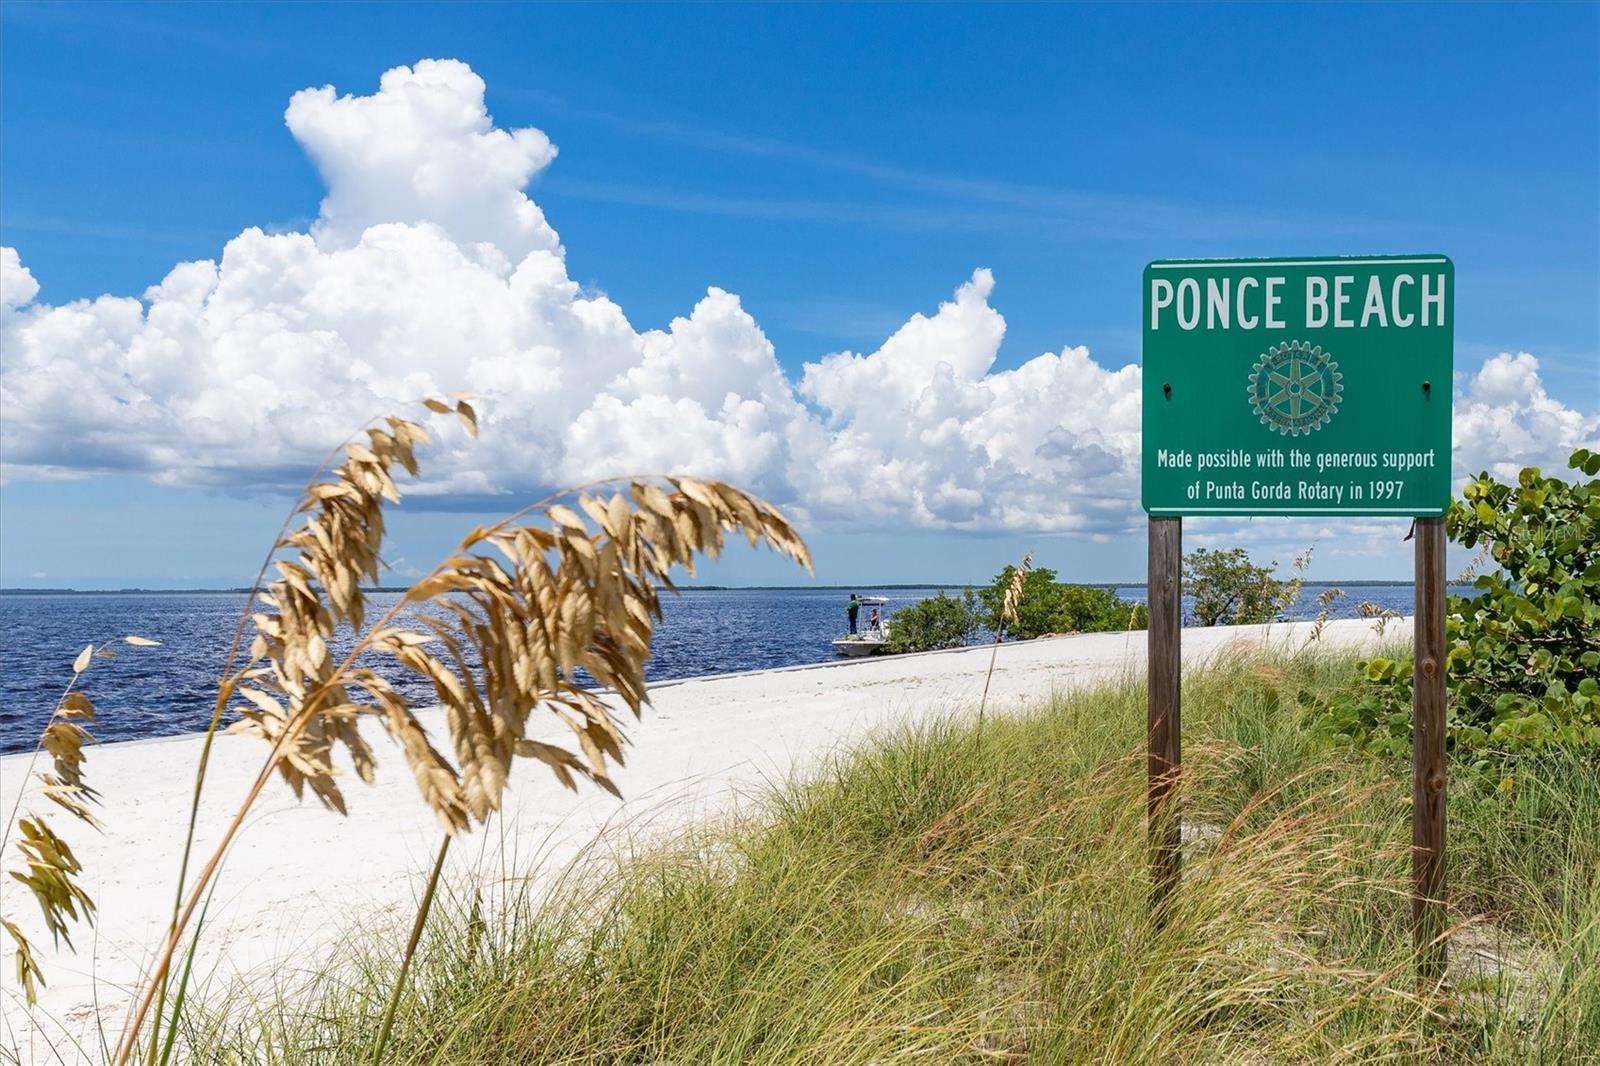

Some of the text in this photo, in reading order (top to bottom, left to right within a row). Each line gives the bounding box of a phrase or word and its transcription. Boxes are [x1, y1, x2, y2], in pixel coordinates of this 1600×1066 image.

[1152, 274, 1446, 330] PONCE BEACH
[1158, 449, 1435, 473] Made possible with the generous support
[1187, 481, 1404, 504] of Punta Gorda Rotary in 1997
